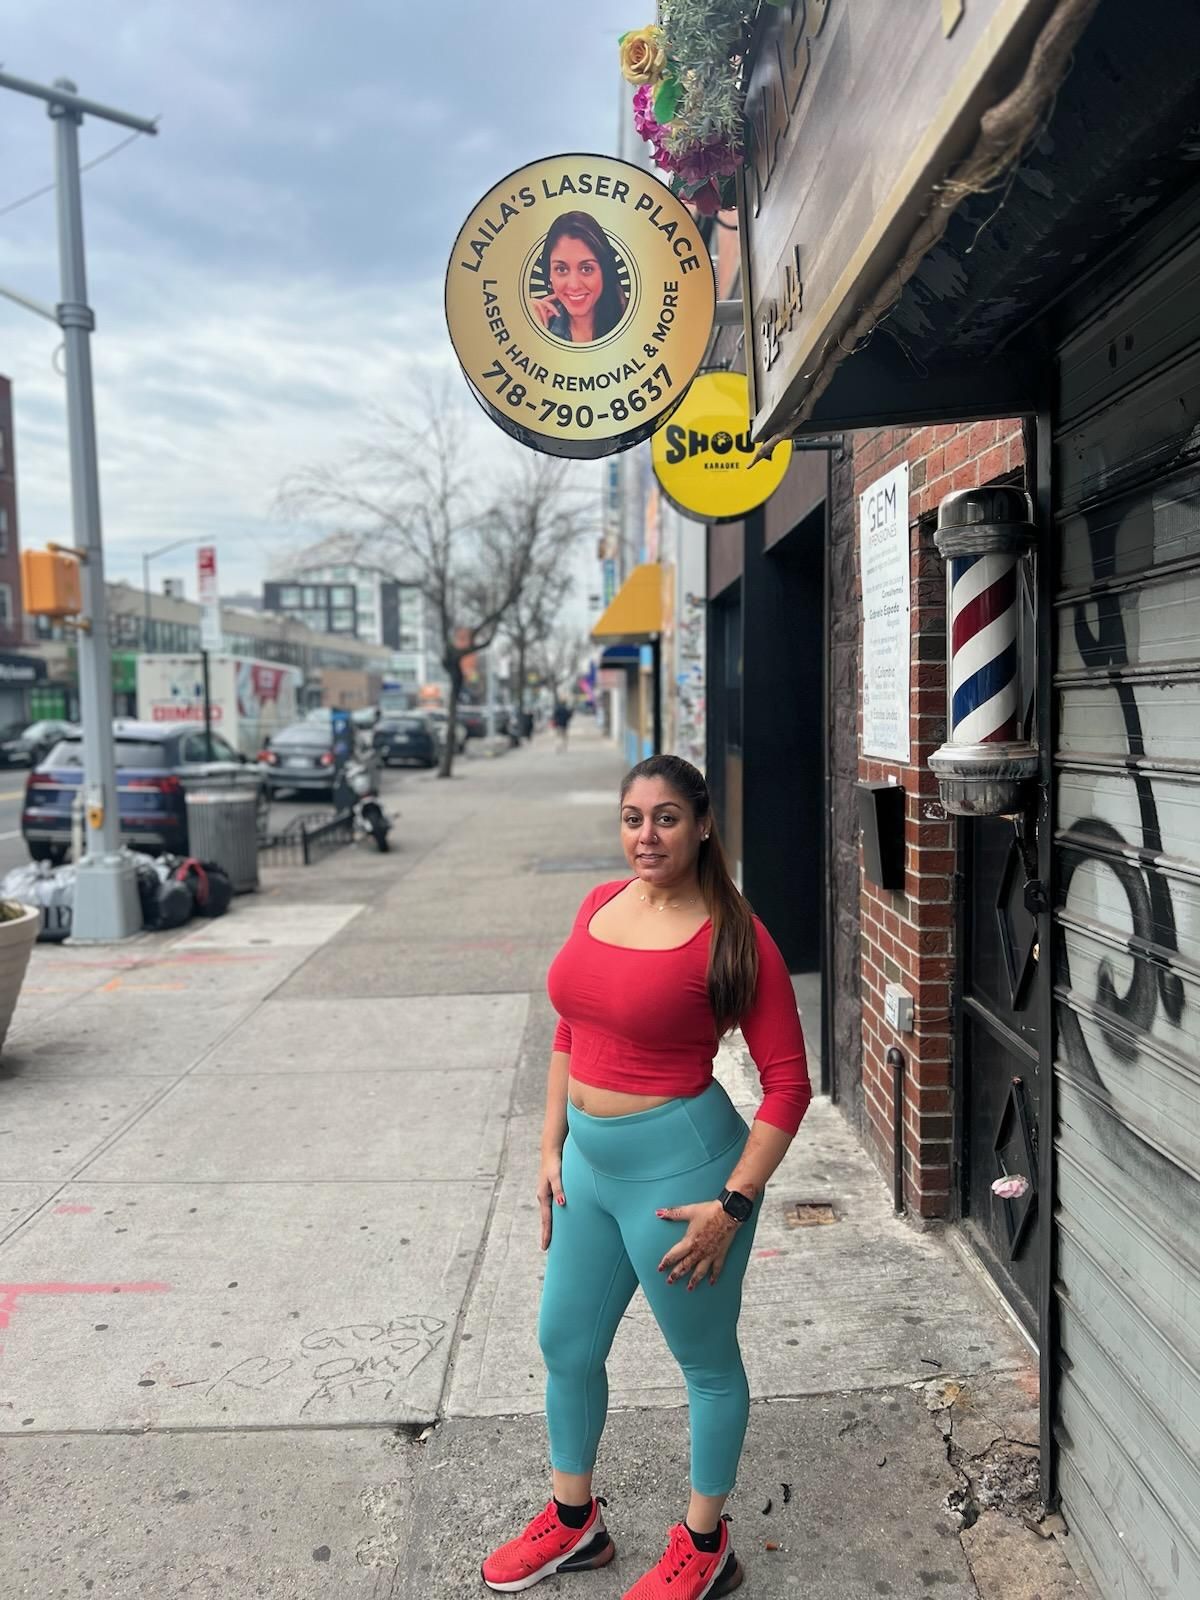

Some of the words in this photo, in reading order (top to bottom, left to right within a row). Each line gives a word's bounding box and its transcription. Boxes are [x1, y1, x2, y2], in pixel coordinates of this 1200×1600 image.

[461, 187, 536, 273] LAILA'S
[542, 173, 630, 204] LASER
[634, 193, 700, 275] PLACE
[482, 279, 511, 346] LASER
[505, 343, 549, 385] HAIR
[552, 357, 646, 392] REMOVAL
[642, 343, 658, 358] &
[652, 280, 679, 344] MORE
[481, 359, 673, 429] 718-790-8637
[704, 461, 740, 471] KARAOKE
[867, 481, 896, 533] GEM
